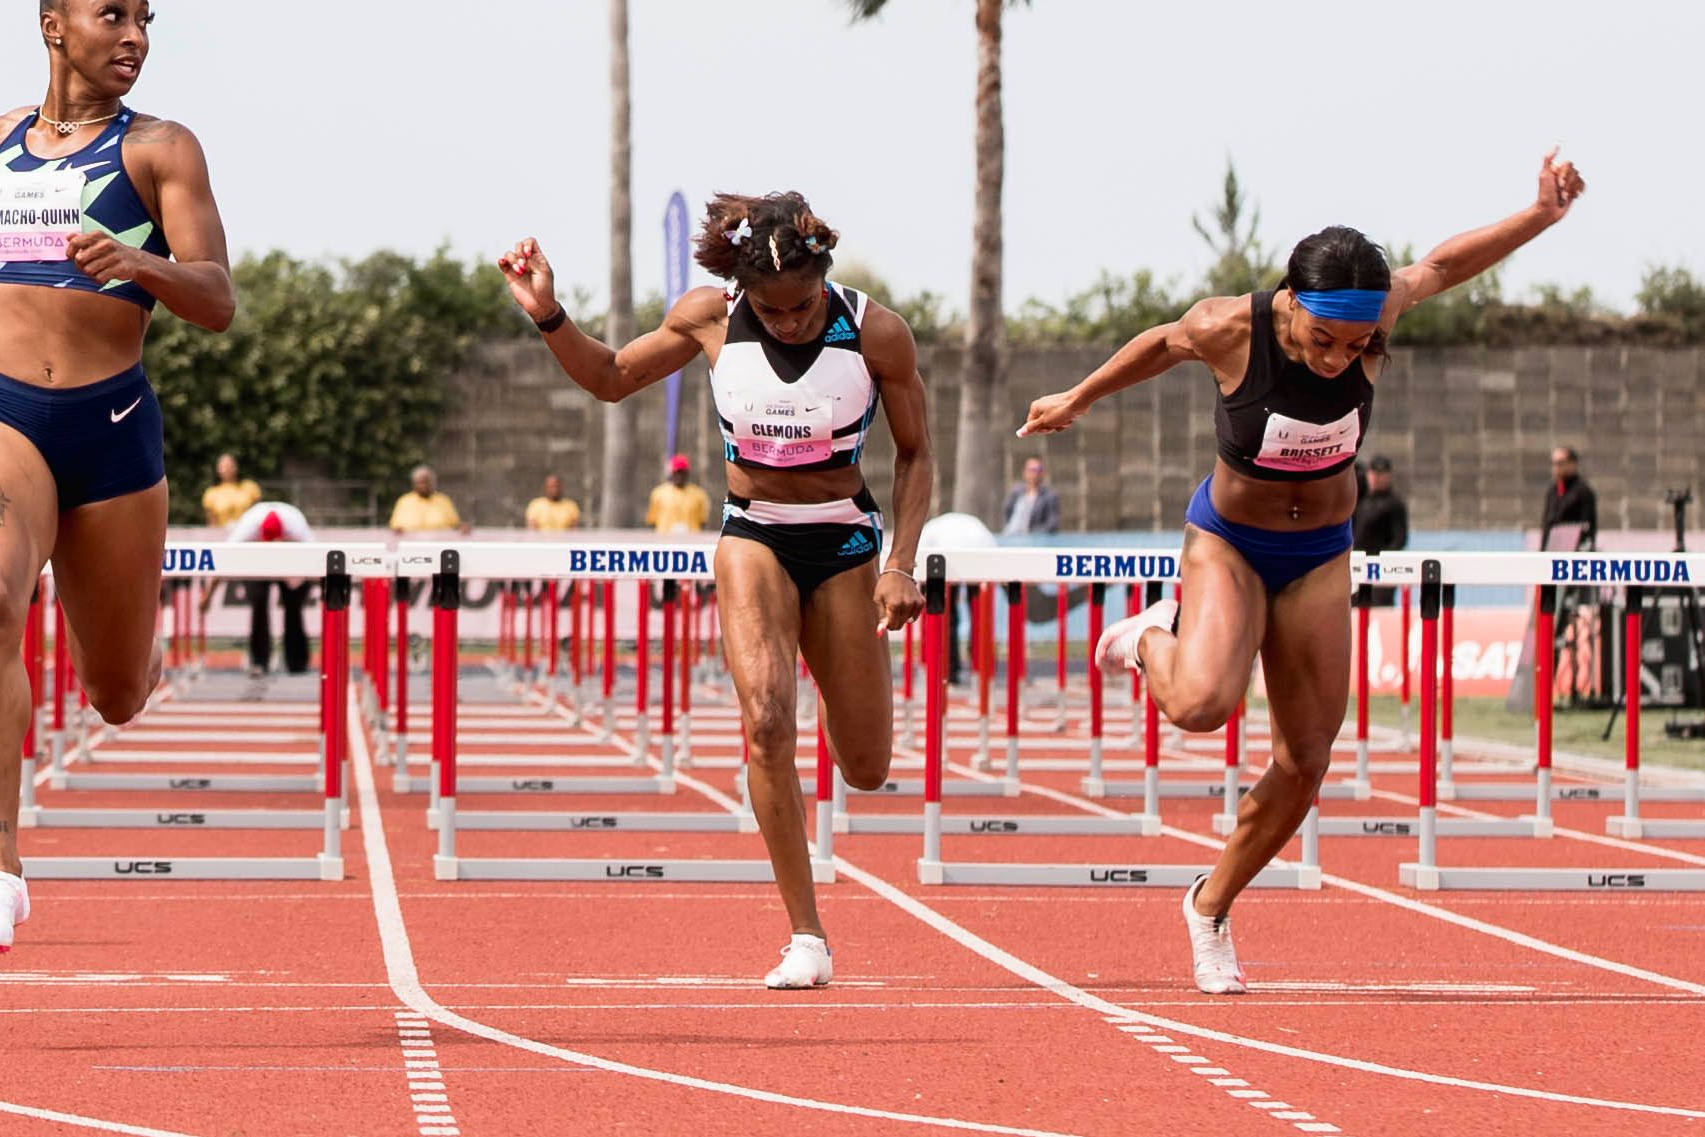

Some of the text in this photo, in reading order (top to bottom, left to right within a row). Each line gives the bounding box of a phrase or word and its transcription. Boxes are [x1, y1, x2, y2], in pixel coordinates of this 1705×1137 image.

[15, 191, 45, 199] GAMES
[824, 332, 856, 343] adidas
[765, 407, 796, 416] GAMES
[751, 423, 812, 440] CLEMONS
[751, 442, 815, 457] BERMUDA
[1279, 443, 1344, 458] BRISSETT
[351, 556, 382, 565] UCS
[402, 556, 433, 564] UCS
[569, 550, 708, 573] BERMUDA
[1551, 559, 1690, 582] BERMUDA
[156, 814, 205, 825] UCS
[570, 816, 617, 828] UCS
[970, 821, 1018, 832] UCS
[1363, 821, 1410, 834] UCS
[114, 862, 172, 874] UCS
[606, 865, 664, 877] UCS
[1090, 869, 1148, 882] UCS
[1588, 874, 1645, 887] UCS
